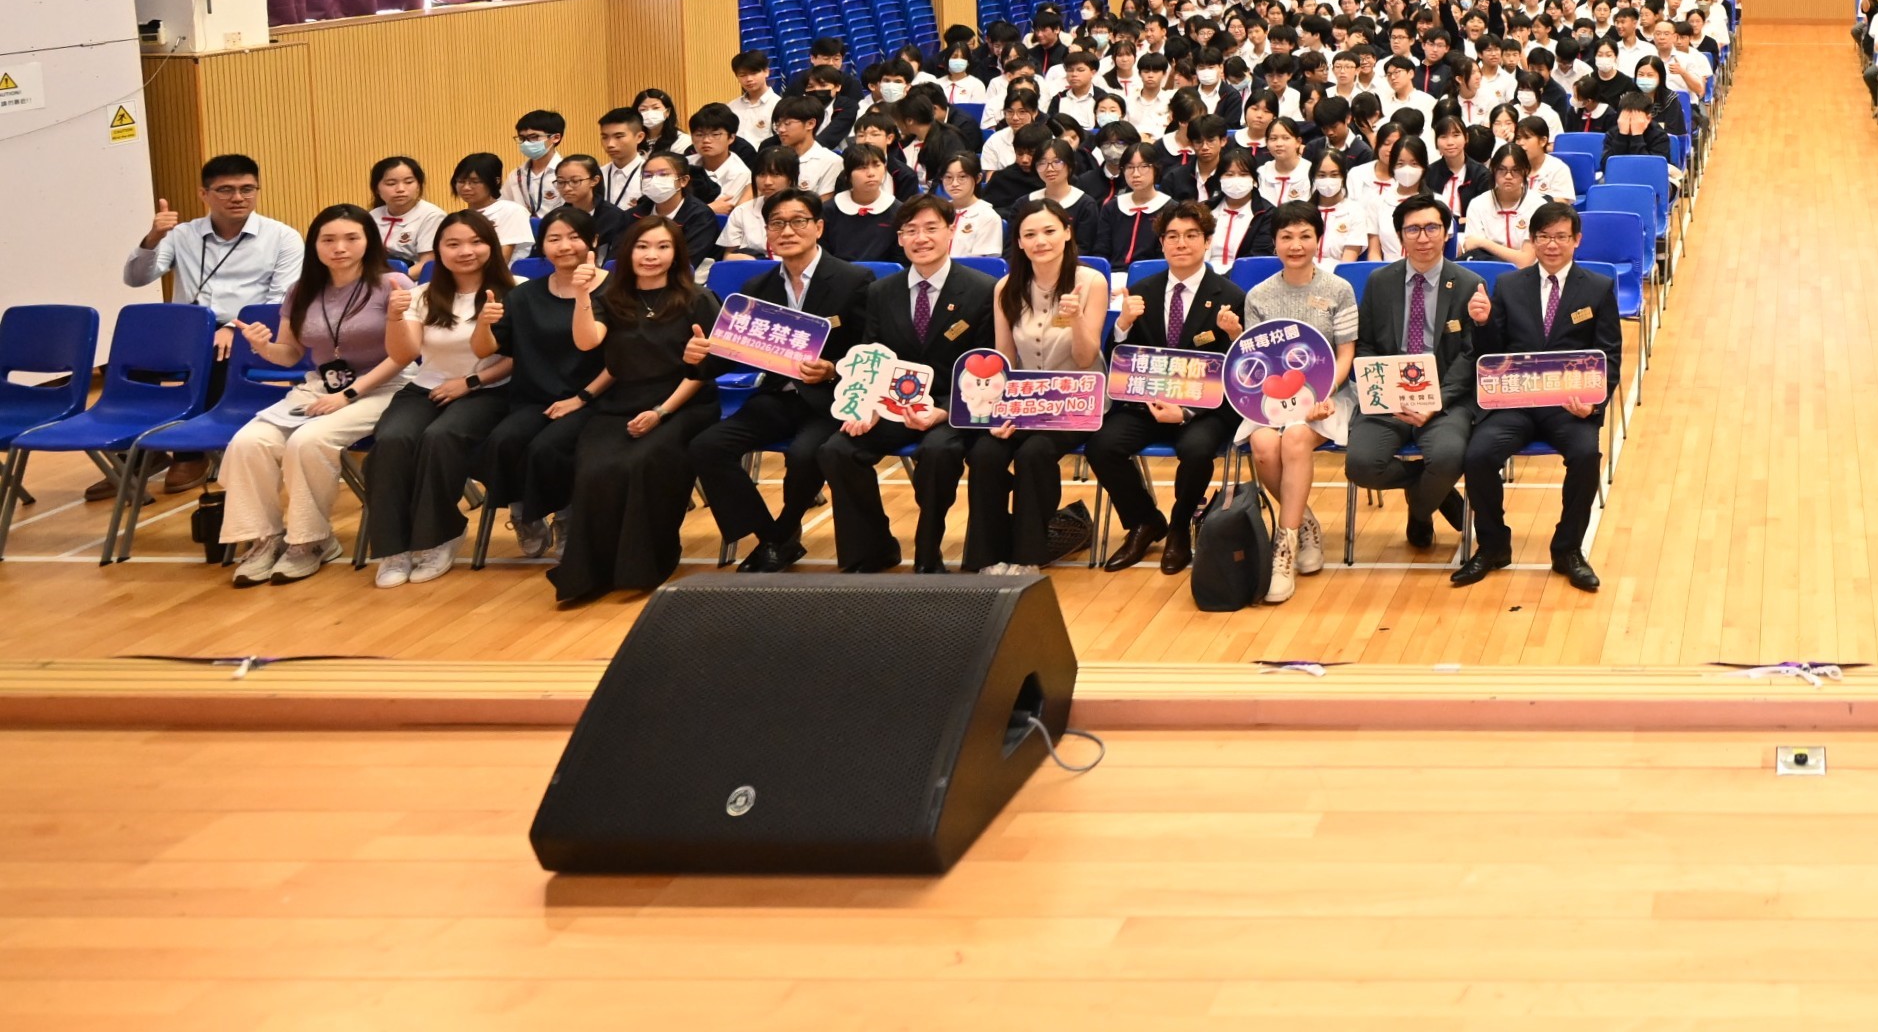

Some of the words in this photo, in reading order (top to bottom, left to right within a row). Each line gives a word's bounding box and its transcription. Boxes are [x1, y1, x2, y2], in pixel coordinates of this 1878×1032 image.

[728, 311, 811, 351] 博愛禁毒
[1239, 324, 1300, 354] 無毒校園
[1131, 353, 1208, 379] 博愛與你
[1127, 375, 1204, 401] 攜手抗毒
[1480, 370, 1603, 394] 守護社區健康
